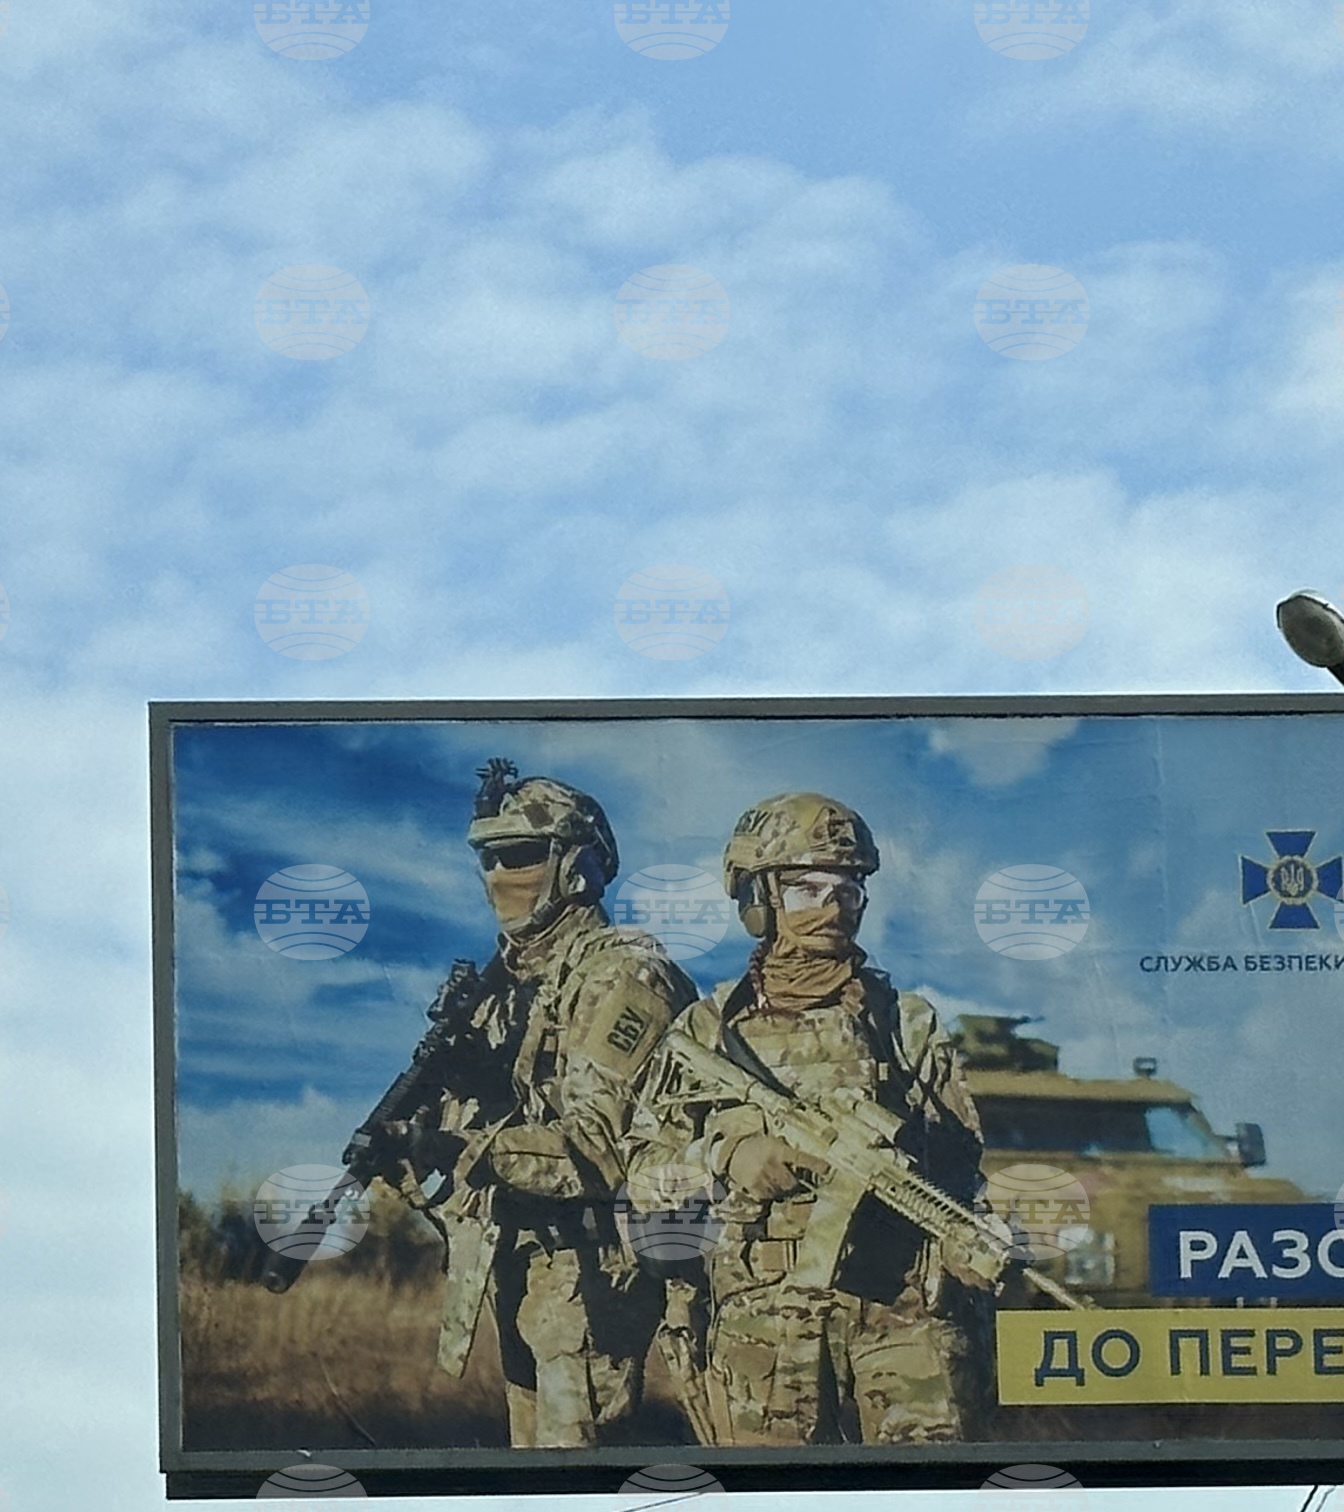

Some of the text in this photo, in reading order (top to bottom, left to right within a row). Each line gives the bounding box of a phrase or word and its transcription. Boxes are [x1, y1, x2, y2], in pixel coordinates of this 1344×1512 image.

[1140, 955, 1237, 973] СЛУЖБА
[607, 1006, 645, 1053] СБУ
[1034, 1328, 1142, 1387] ДО
